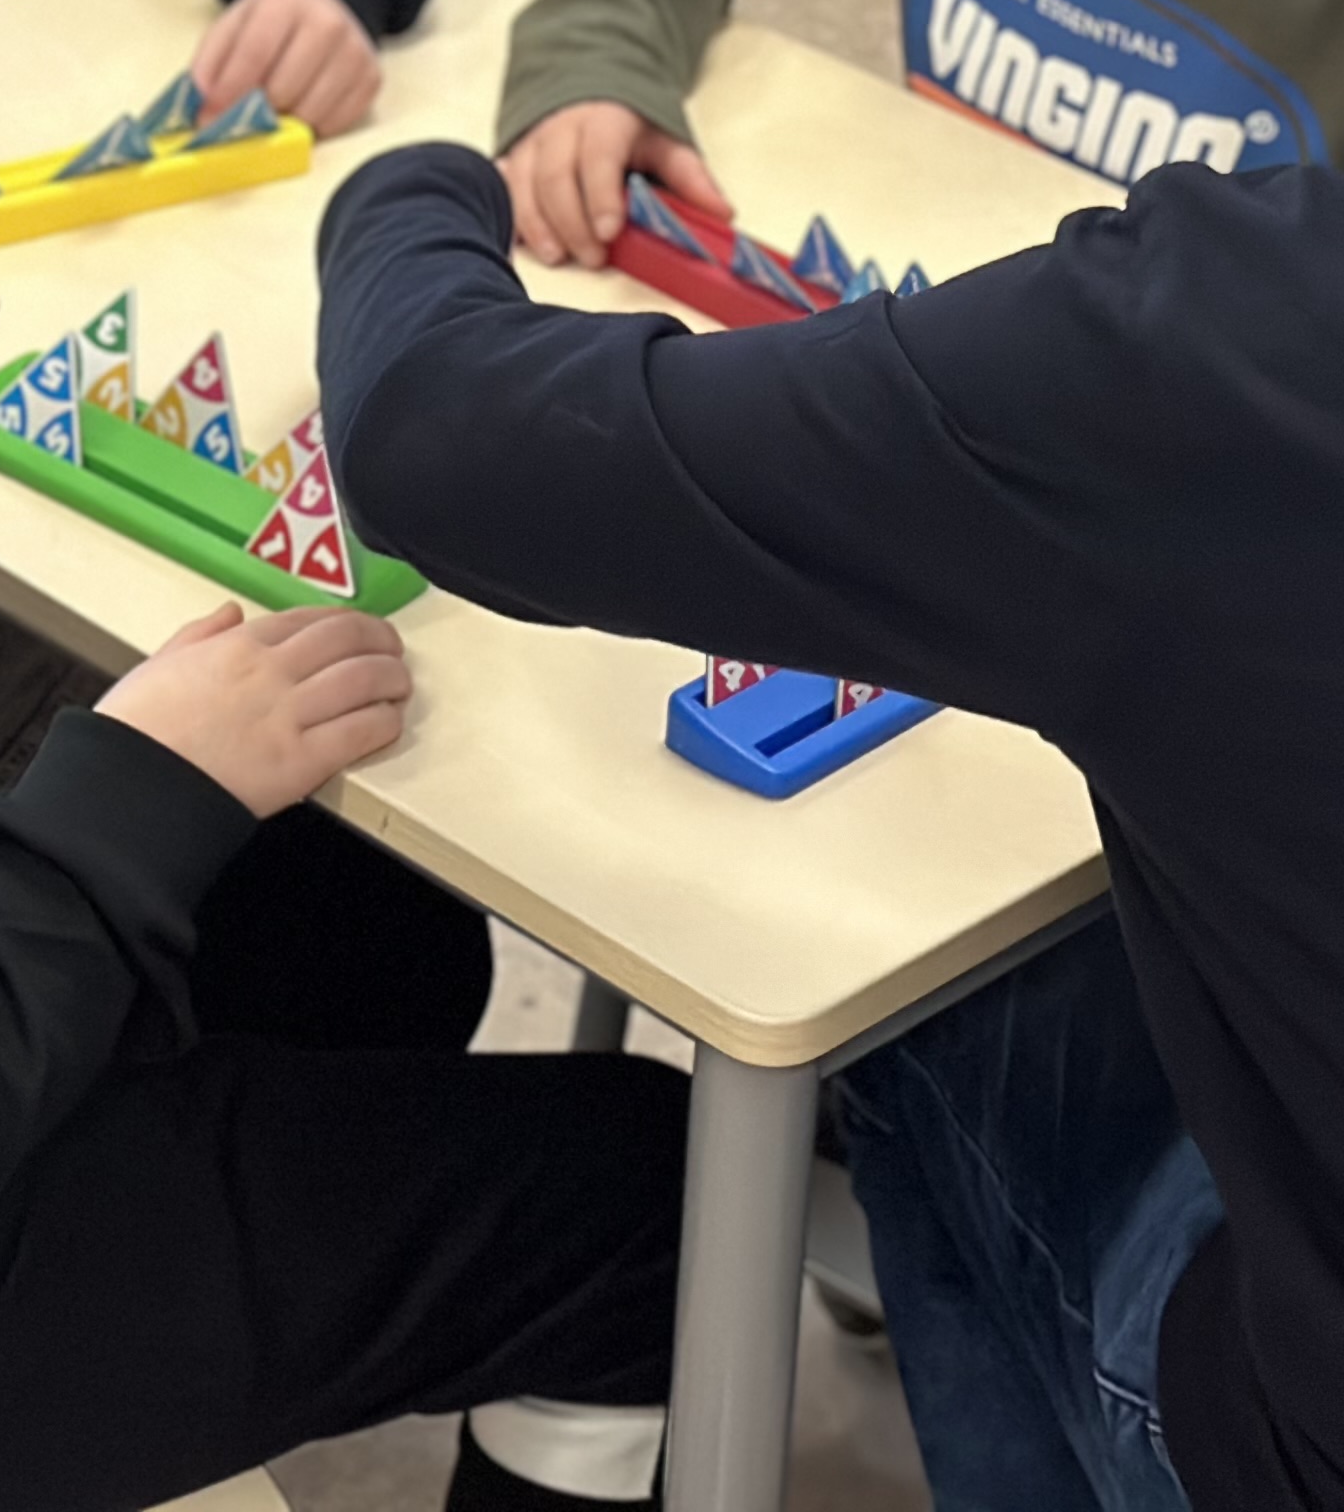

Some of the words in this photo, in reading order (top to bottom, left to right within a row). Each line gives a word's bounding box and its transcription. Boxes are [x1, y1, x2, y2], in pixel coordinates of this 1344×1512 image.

[96, 312, 125, 345] 3
[38, 356, 68, 391] 5
[44, 422, 71, 457] 5
[202, 423, 231, 463] 5
[258, 531, 287, 561] 1
[311, 543, 340, 576] 1
